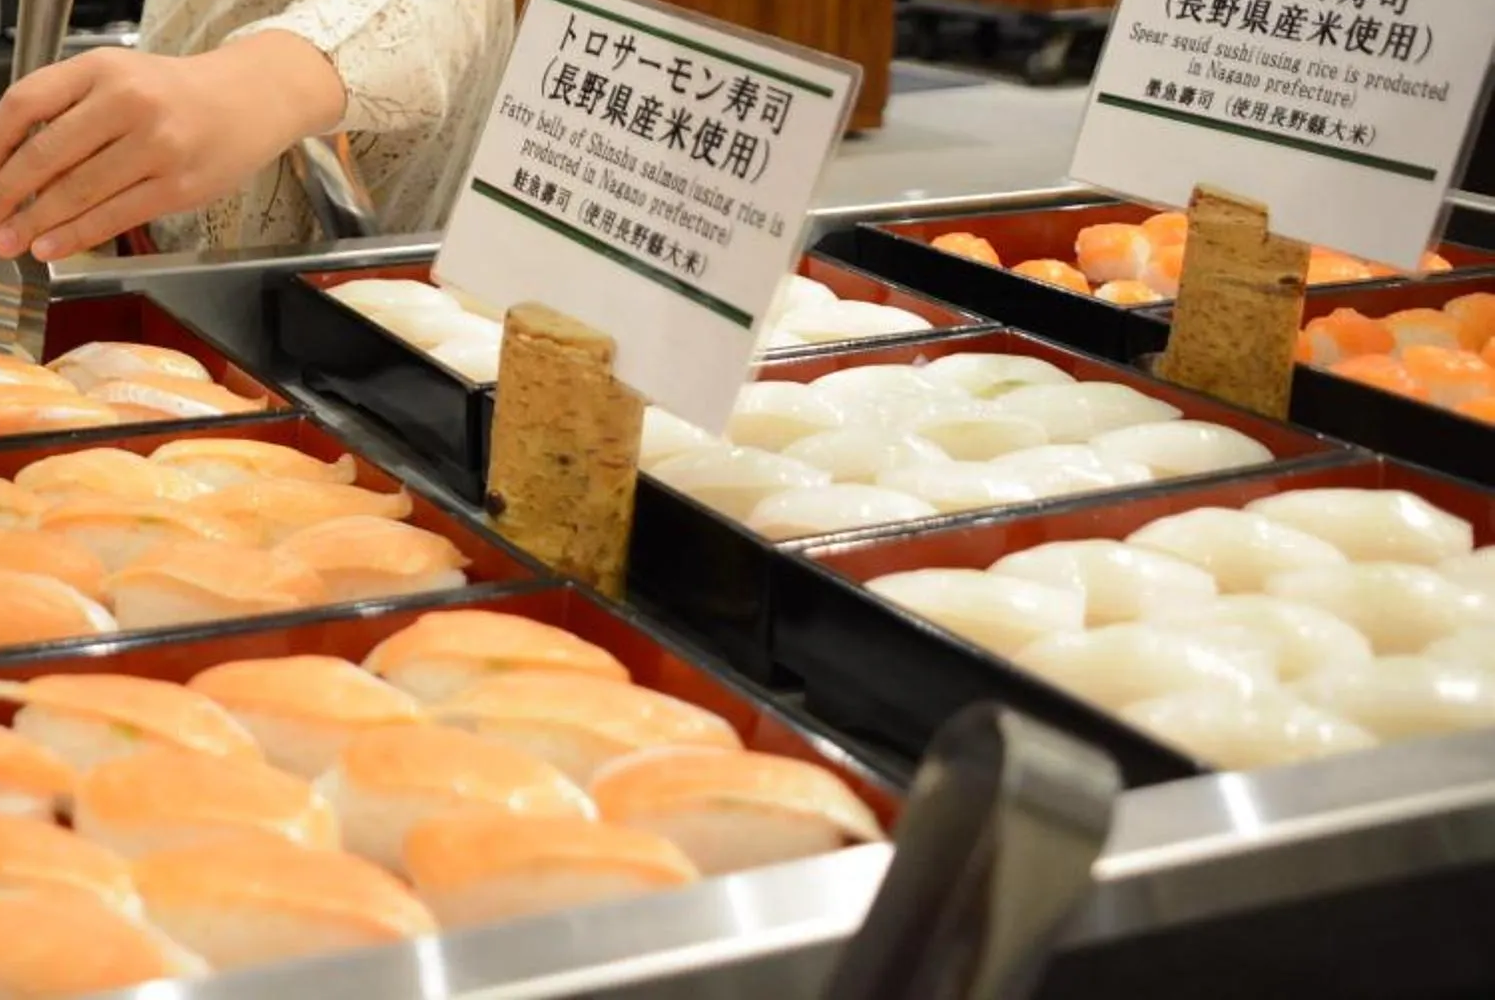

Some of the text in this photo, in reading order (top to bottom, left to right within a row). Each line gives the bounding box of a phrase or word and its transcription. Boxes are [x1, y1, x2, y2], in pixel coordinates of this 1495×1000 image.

[559, 12, 794, 136] トロサーモン寿司
[1129, 21, 1168, 45] Spear
[1171, 33, 1213, 54] squid
[1307, 60, 1338, 81] rice
[1344, 63, 1360, 84] is
[1364, 72, 1451, 102] producted
[1187, 56, 1202, 76] in
[1206, 59, 1261, 88] Nagano
[499, 93, 535, 127] Fatty
[535, 109, 567, 142] belly
[569, 127, 588, 149] of
[586, 132, 639, 173] Shinshu
[736, 201, 766, 230] rice
[768, 212, 785, 239] is
[540, 57, 771, 184] （長野県産米使用）
[582, 161, 597, 185] in
[598, 167, 648, 208] Nagano
